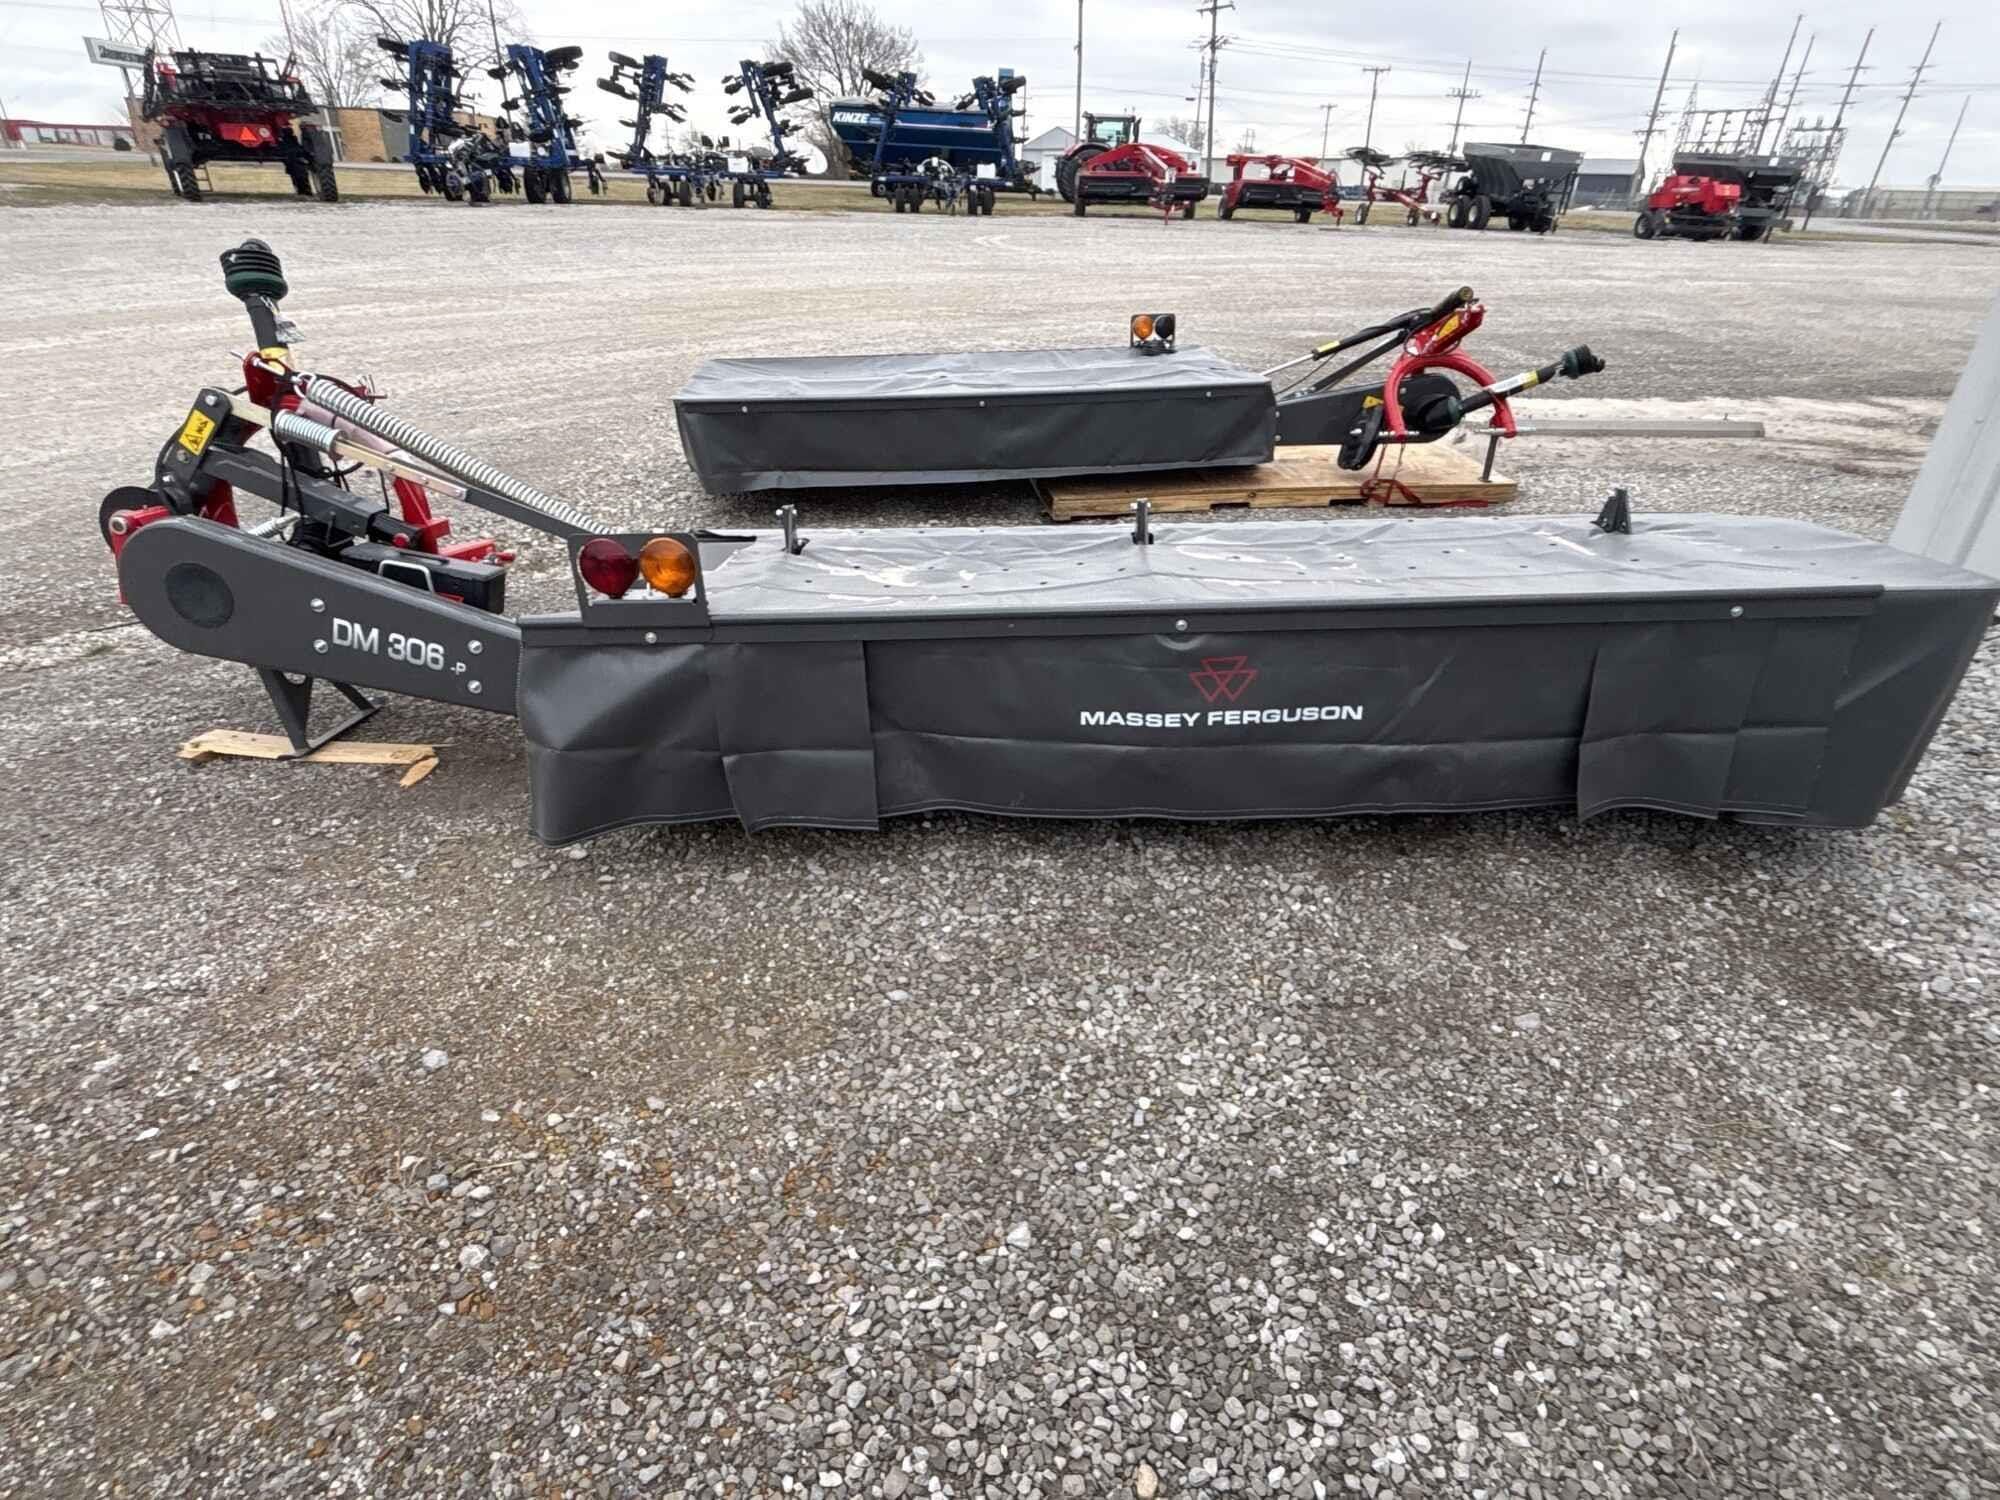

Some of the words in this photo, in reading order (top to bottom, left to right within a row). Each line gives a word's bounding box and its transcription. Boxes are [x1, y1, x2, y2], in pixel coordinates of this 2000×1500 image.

[832, 111, 870, 124] KINZE
[332, 617, 380, 655] DM
[387, 632, 445, 671] 306
[1079, 710, 1200, 728] MASSEY
[1206, 705, 1364, 726] FERGUSON
